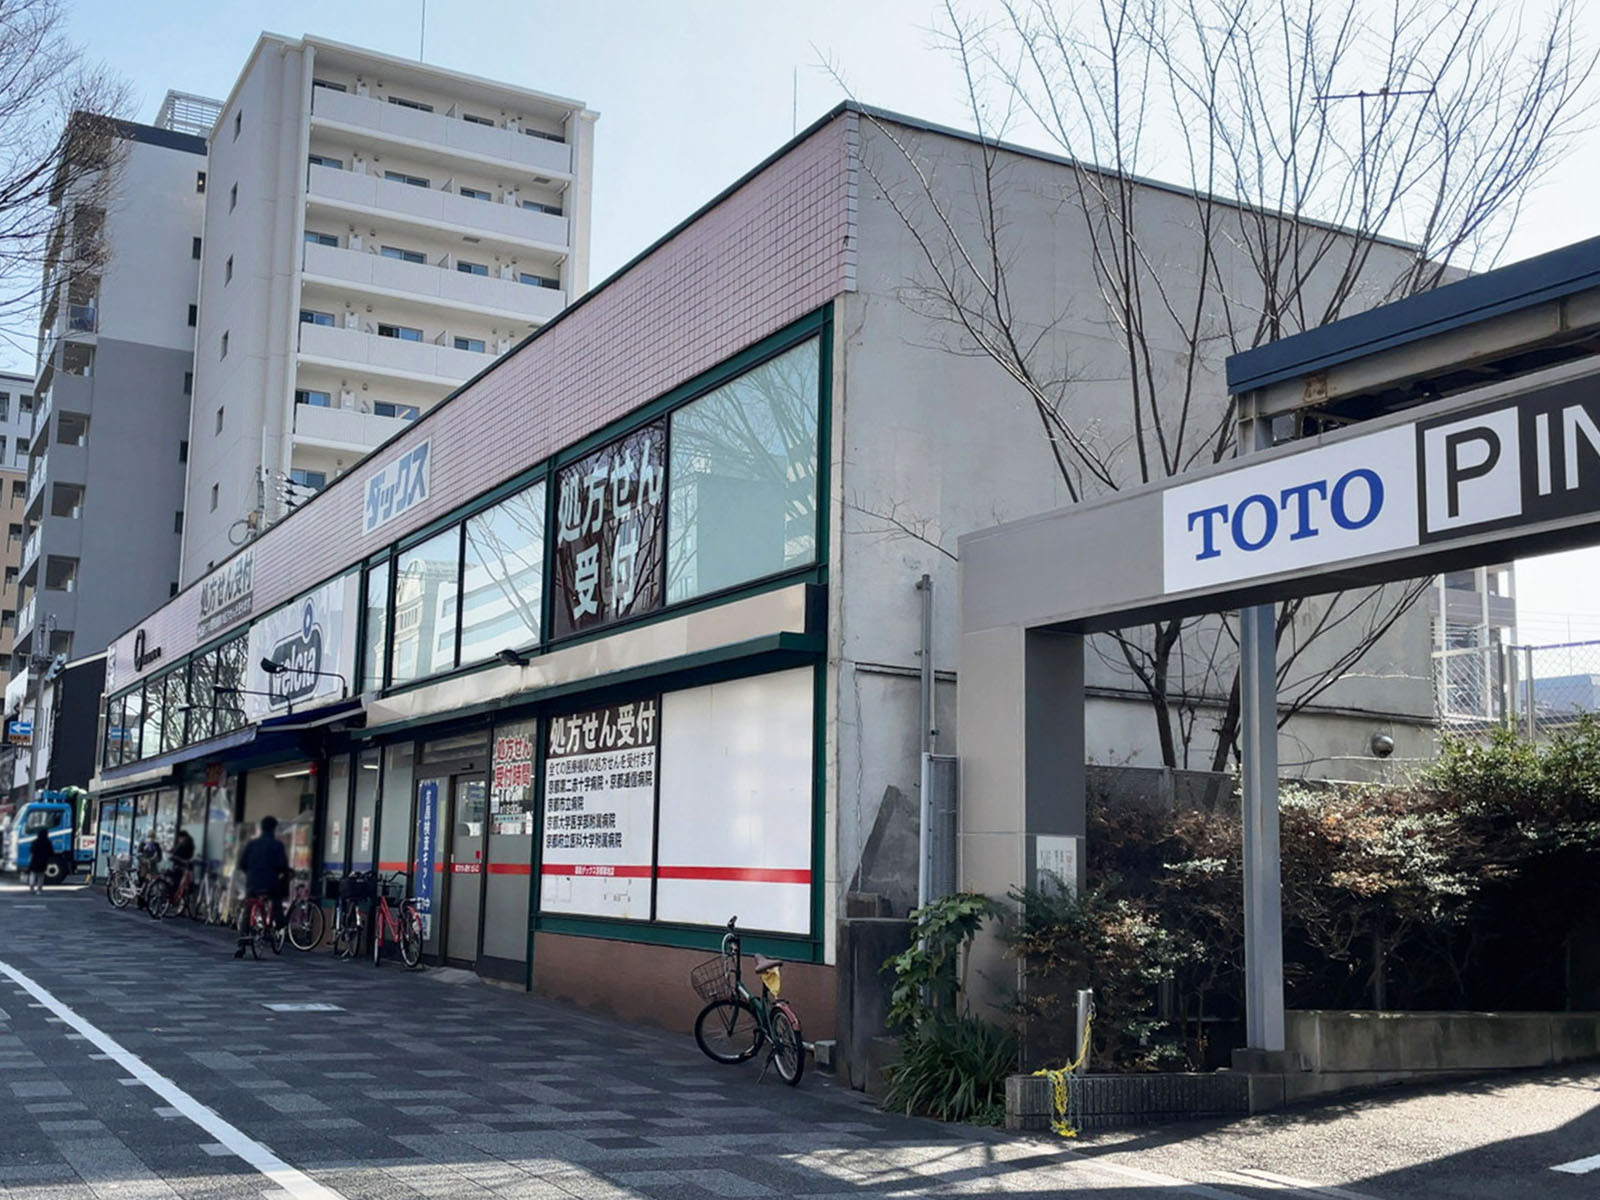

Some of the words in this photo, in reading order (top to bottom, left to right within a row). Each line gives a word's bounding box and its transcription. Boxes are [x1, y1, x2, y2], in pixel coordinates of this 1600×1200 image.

[366, 441, 429, 530] ダックス
[558, 440, 664, 547] 処方せん
[1187, 468, 1385, 561] TOTO
[573, 527, 641, 620] 受付
[549, 700, 656, 755] 処方せん受付
